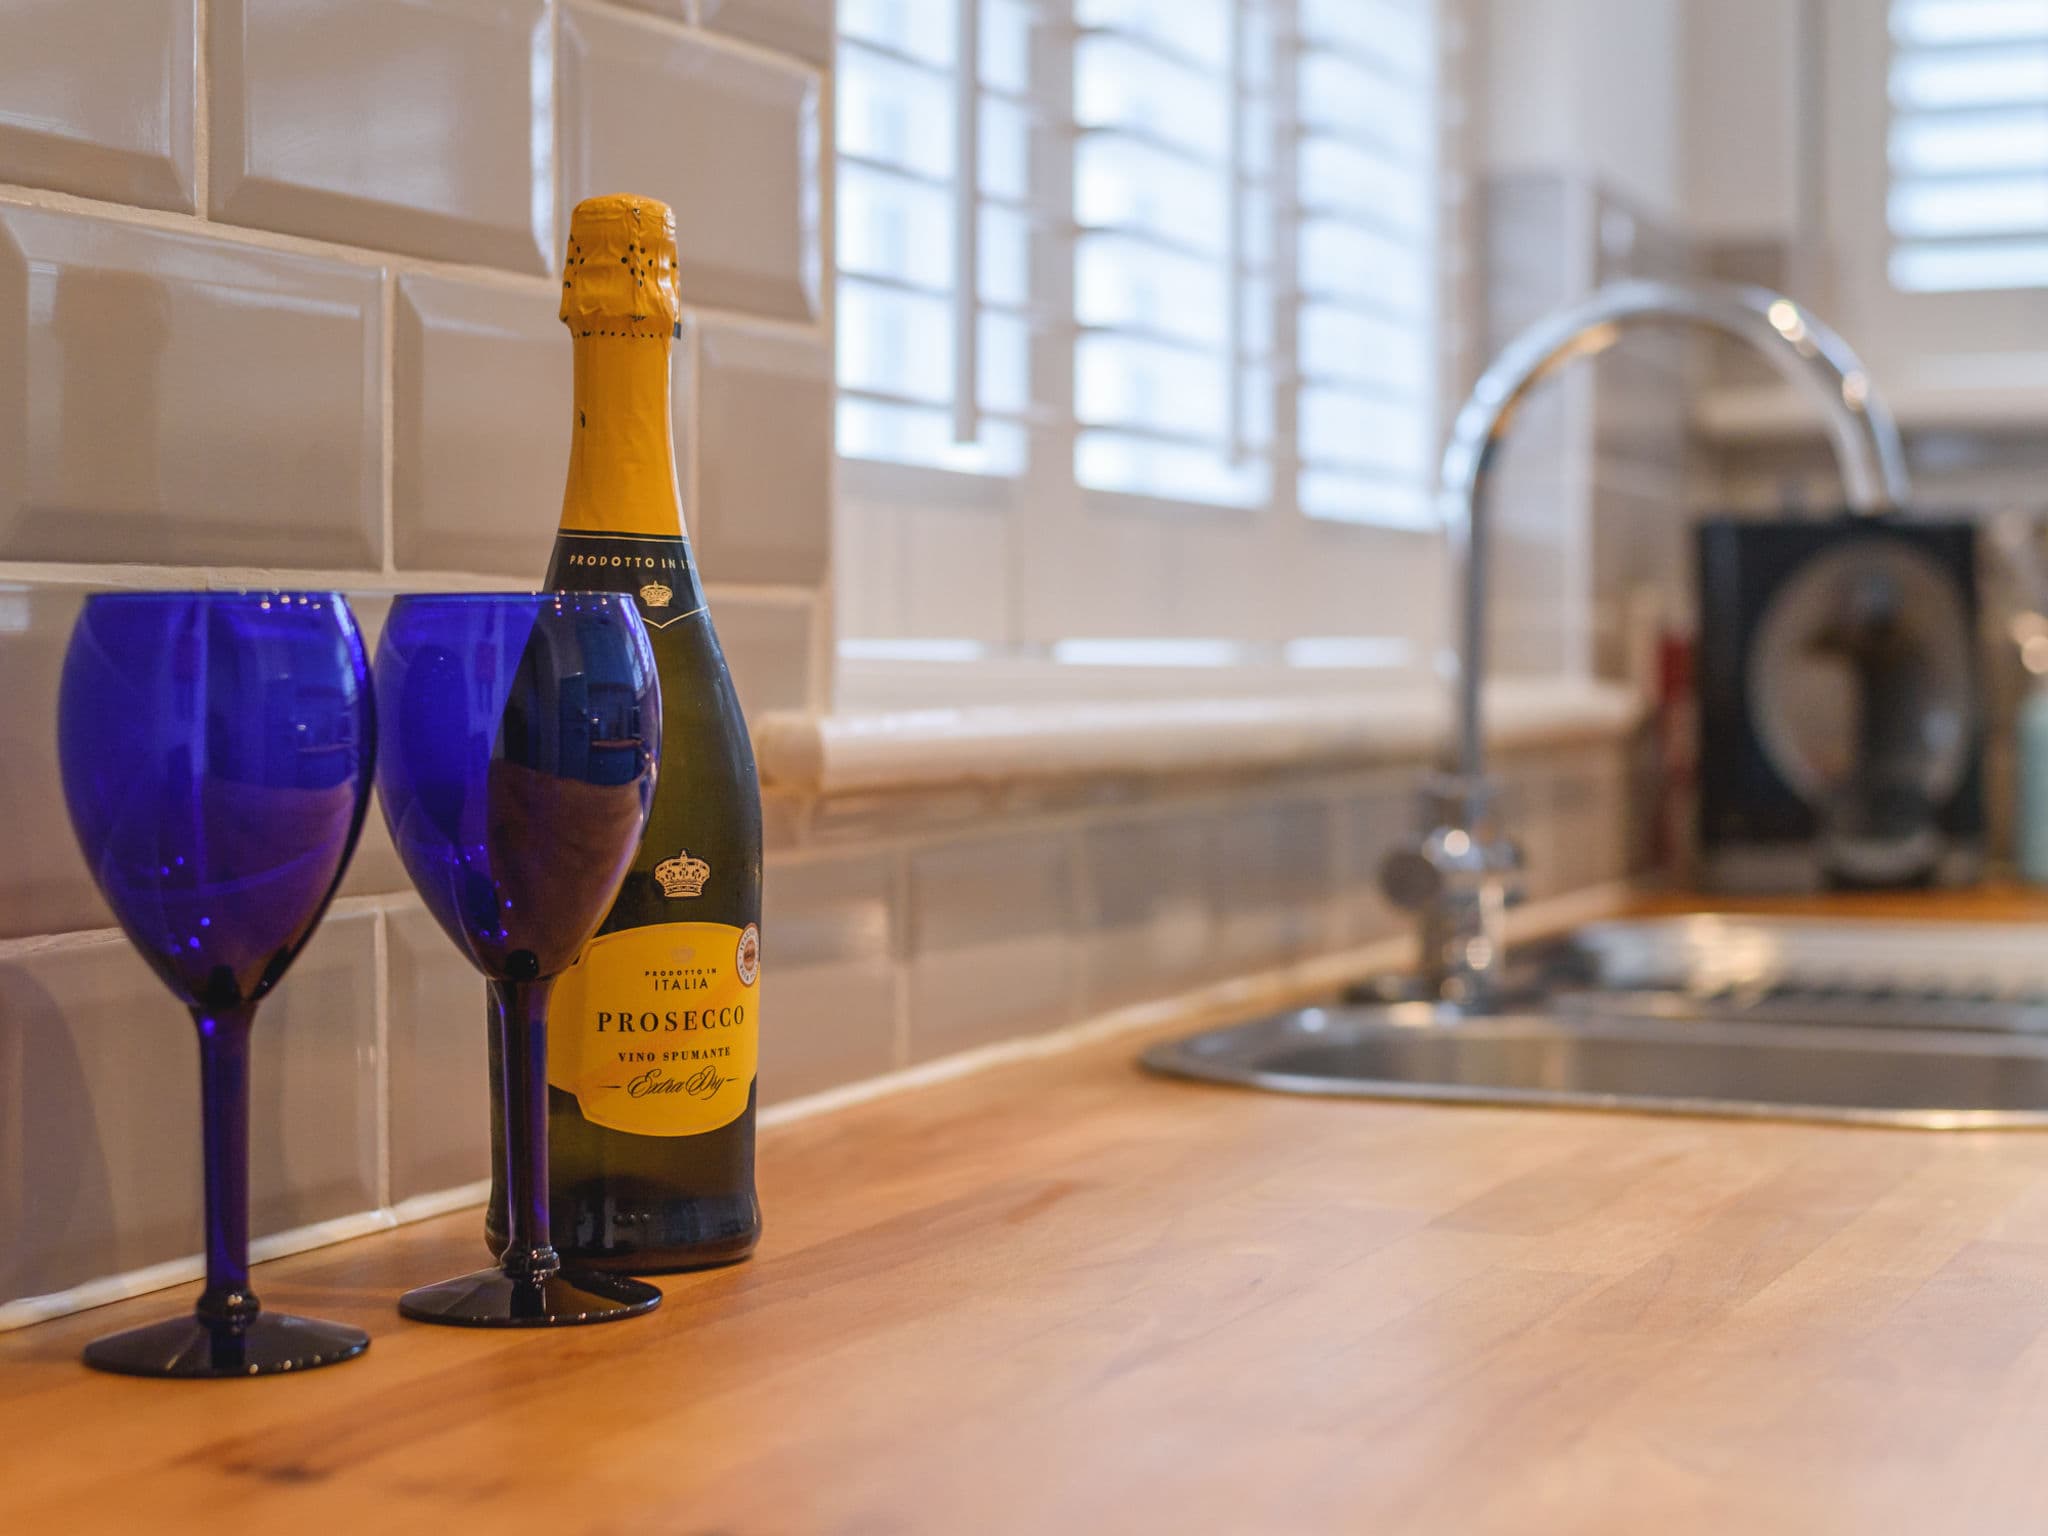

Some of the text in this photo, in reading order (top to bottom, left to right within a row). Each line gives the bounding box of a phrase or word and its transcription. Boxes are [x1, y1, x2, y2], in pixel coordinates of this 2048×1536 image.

[569, 555, 655, 569] PRODOTTO
[661, 558, 676, 569] IN
[645, 968, 702, 977] PRODOTTO
[655, 977, 708, 991] ITALIA
[596, 1005, 744, 1033] PROSECCO
[618, 1047, 731, 1063] VINO SPUMANTE
[627, 1065, 724, 1101] Extra Dry
